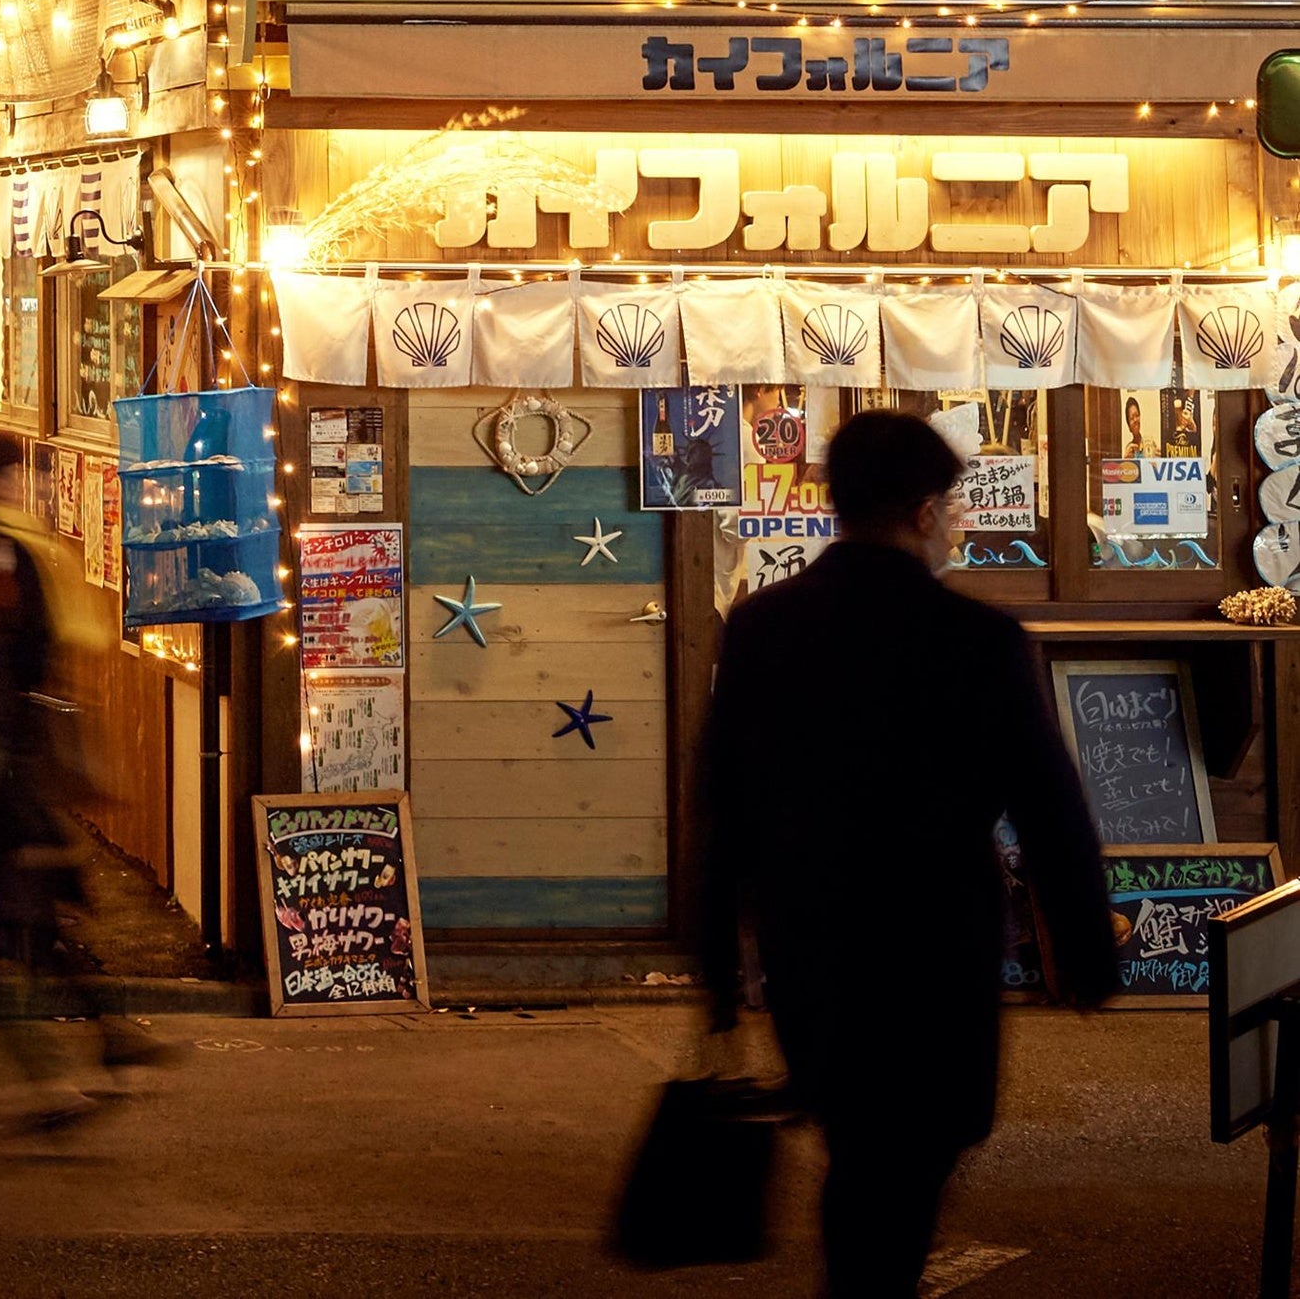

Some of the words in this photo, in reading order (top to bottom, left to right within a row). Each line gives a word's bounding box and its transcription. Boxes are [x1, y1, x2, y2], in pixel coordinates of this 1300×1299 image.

[641, 36, 1010, 92] カイフォルニア
[757, 418, 799, 445] 20
[1150, 461, 1203, 482] VISA
[299, 847, 385, 874] パインサワー
[276, 870, 370, 898] キウイサワー
